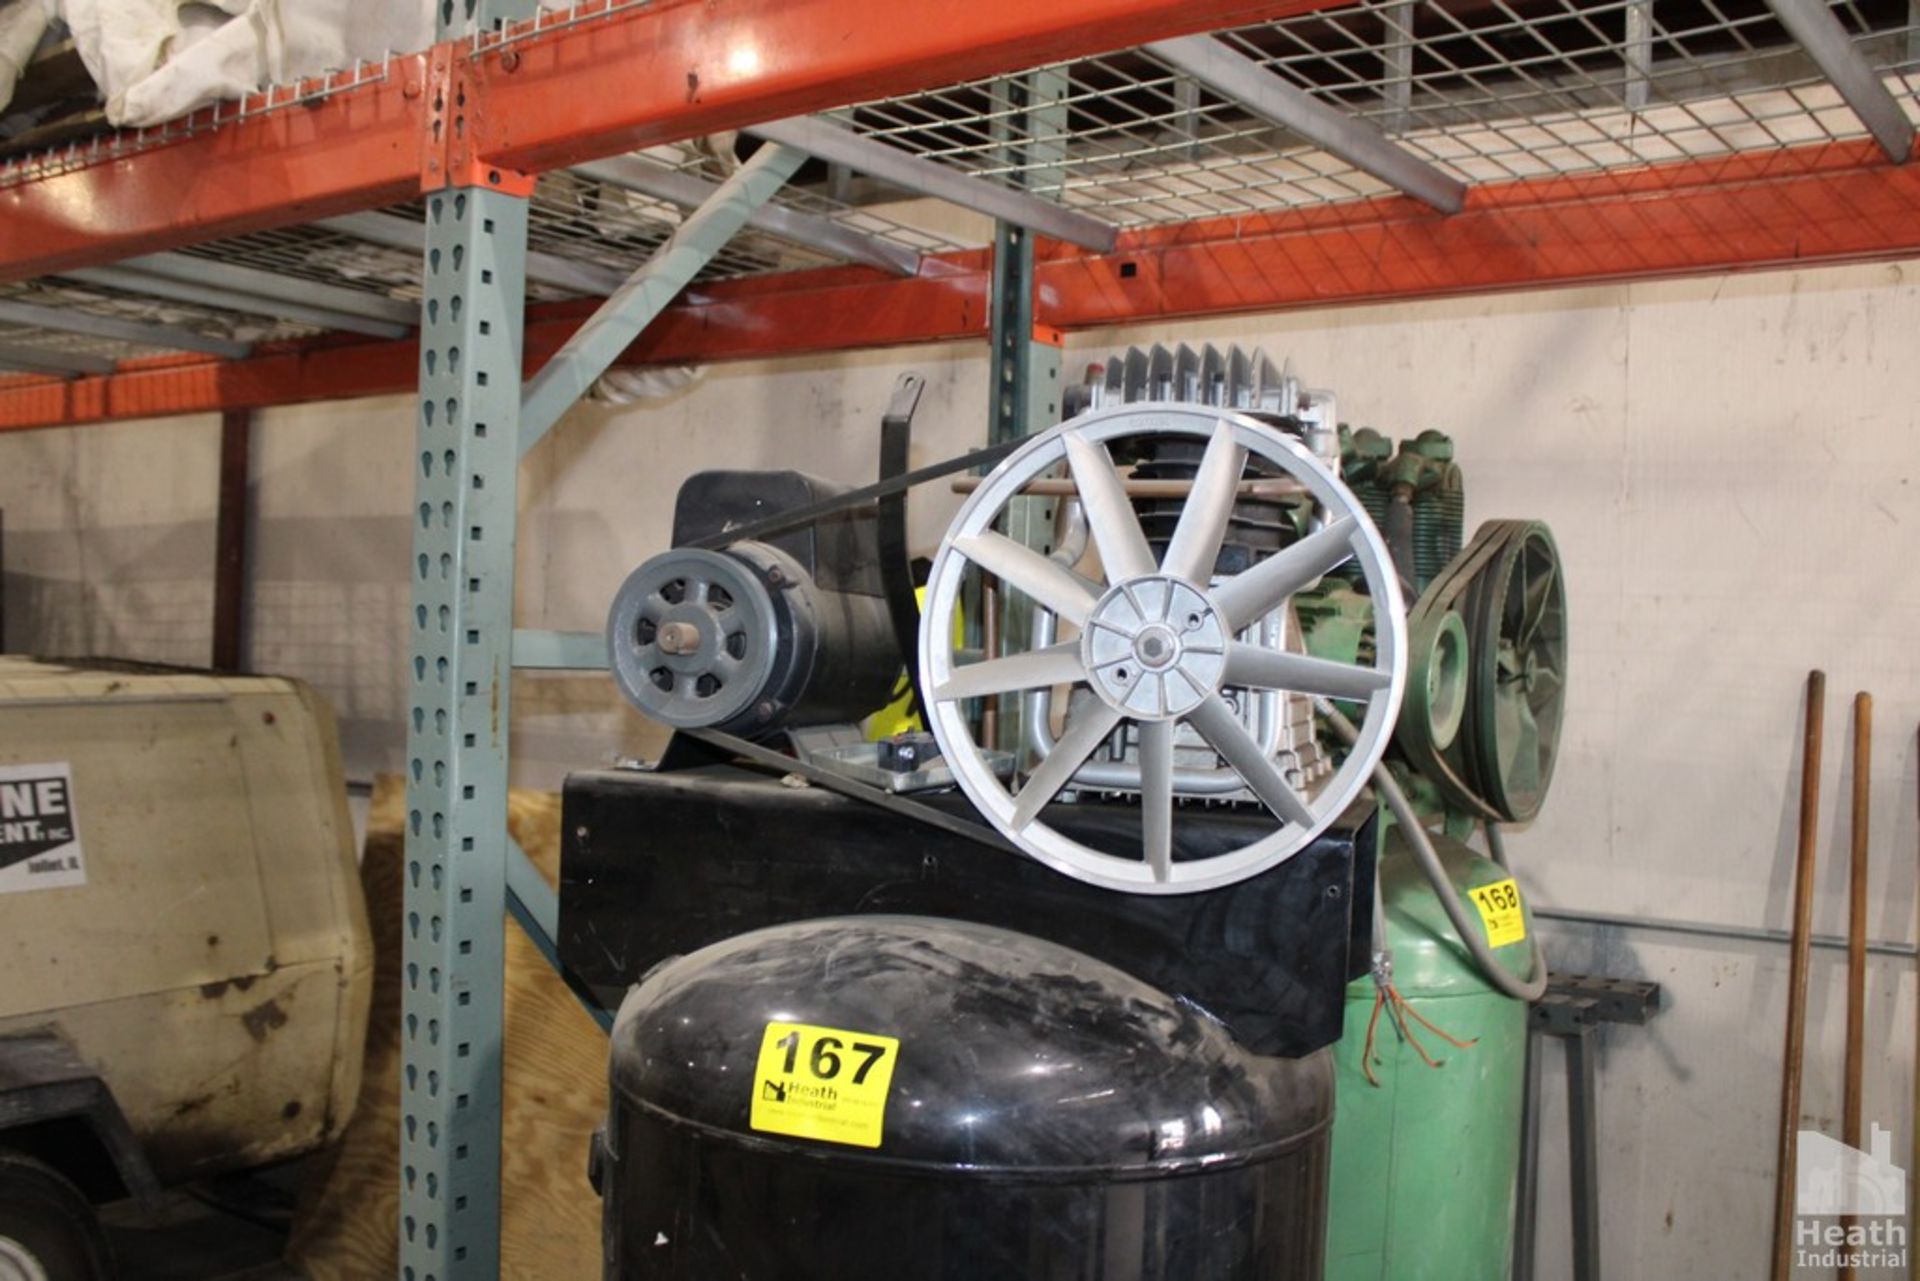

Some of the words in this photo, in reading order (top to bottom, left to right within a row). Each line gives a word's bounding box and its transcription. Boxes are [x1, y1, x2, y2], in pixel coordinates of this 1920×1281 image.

[1479, 885, 1518, 912] 168
[776, 1031, 886, 1085] 167
[788, 1082, 838, 1100] Heath
